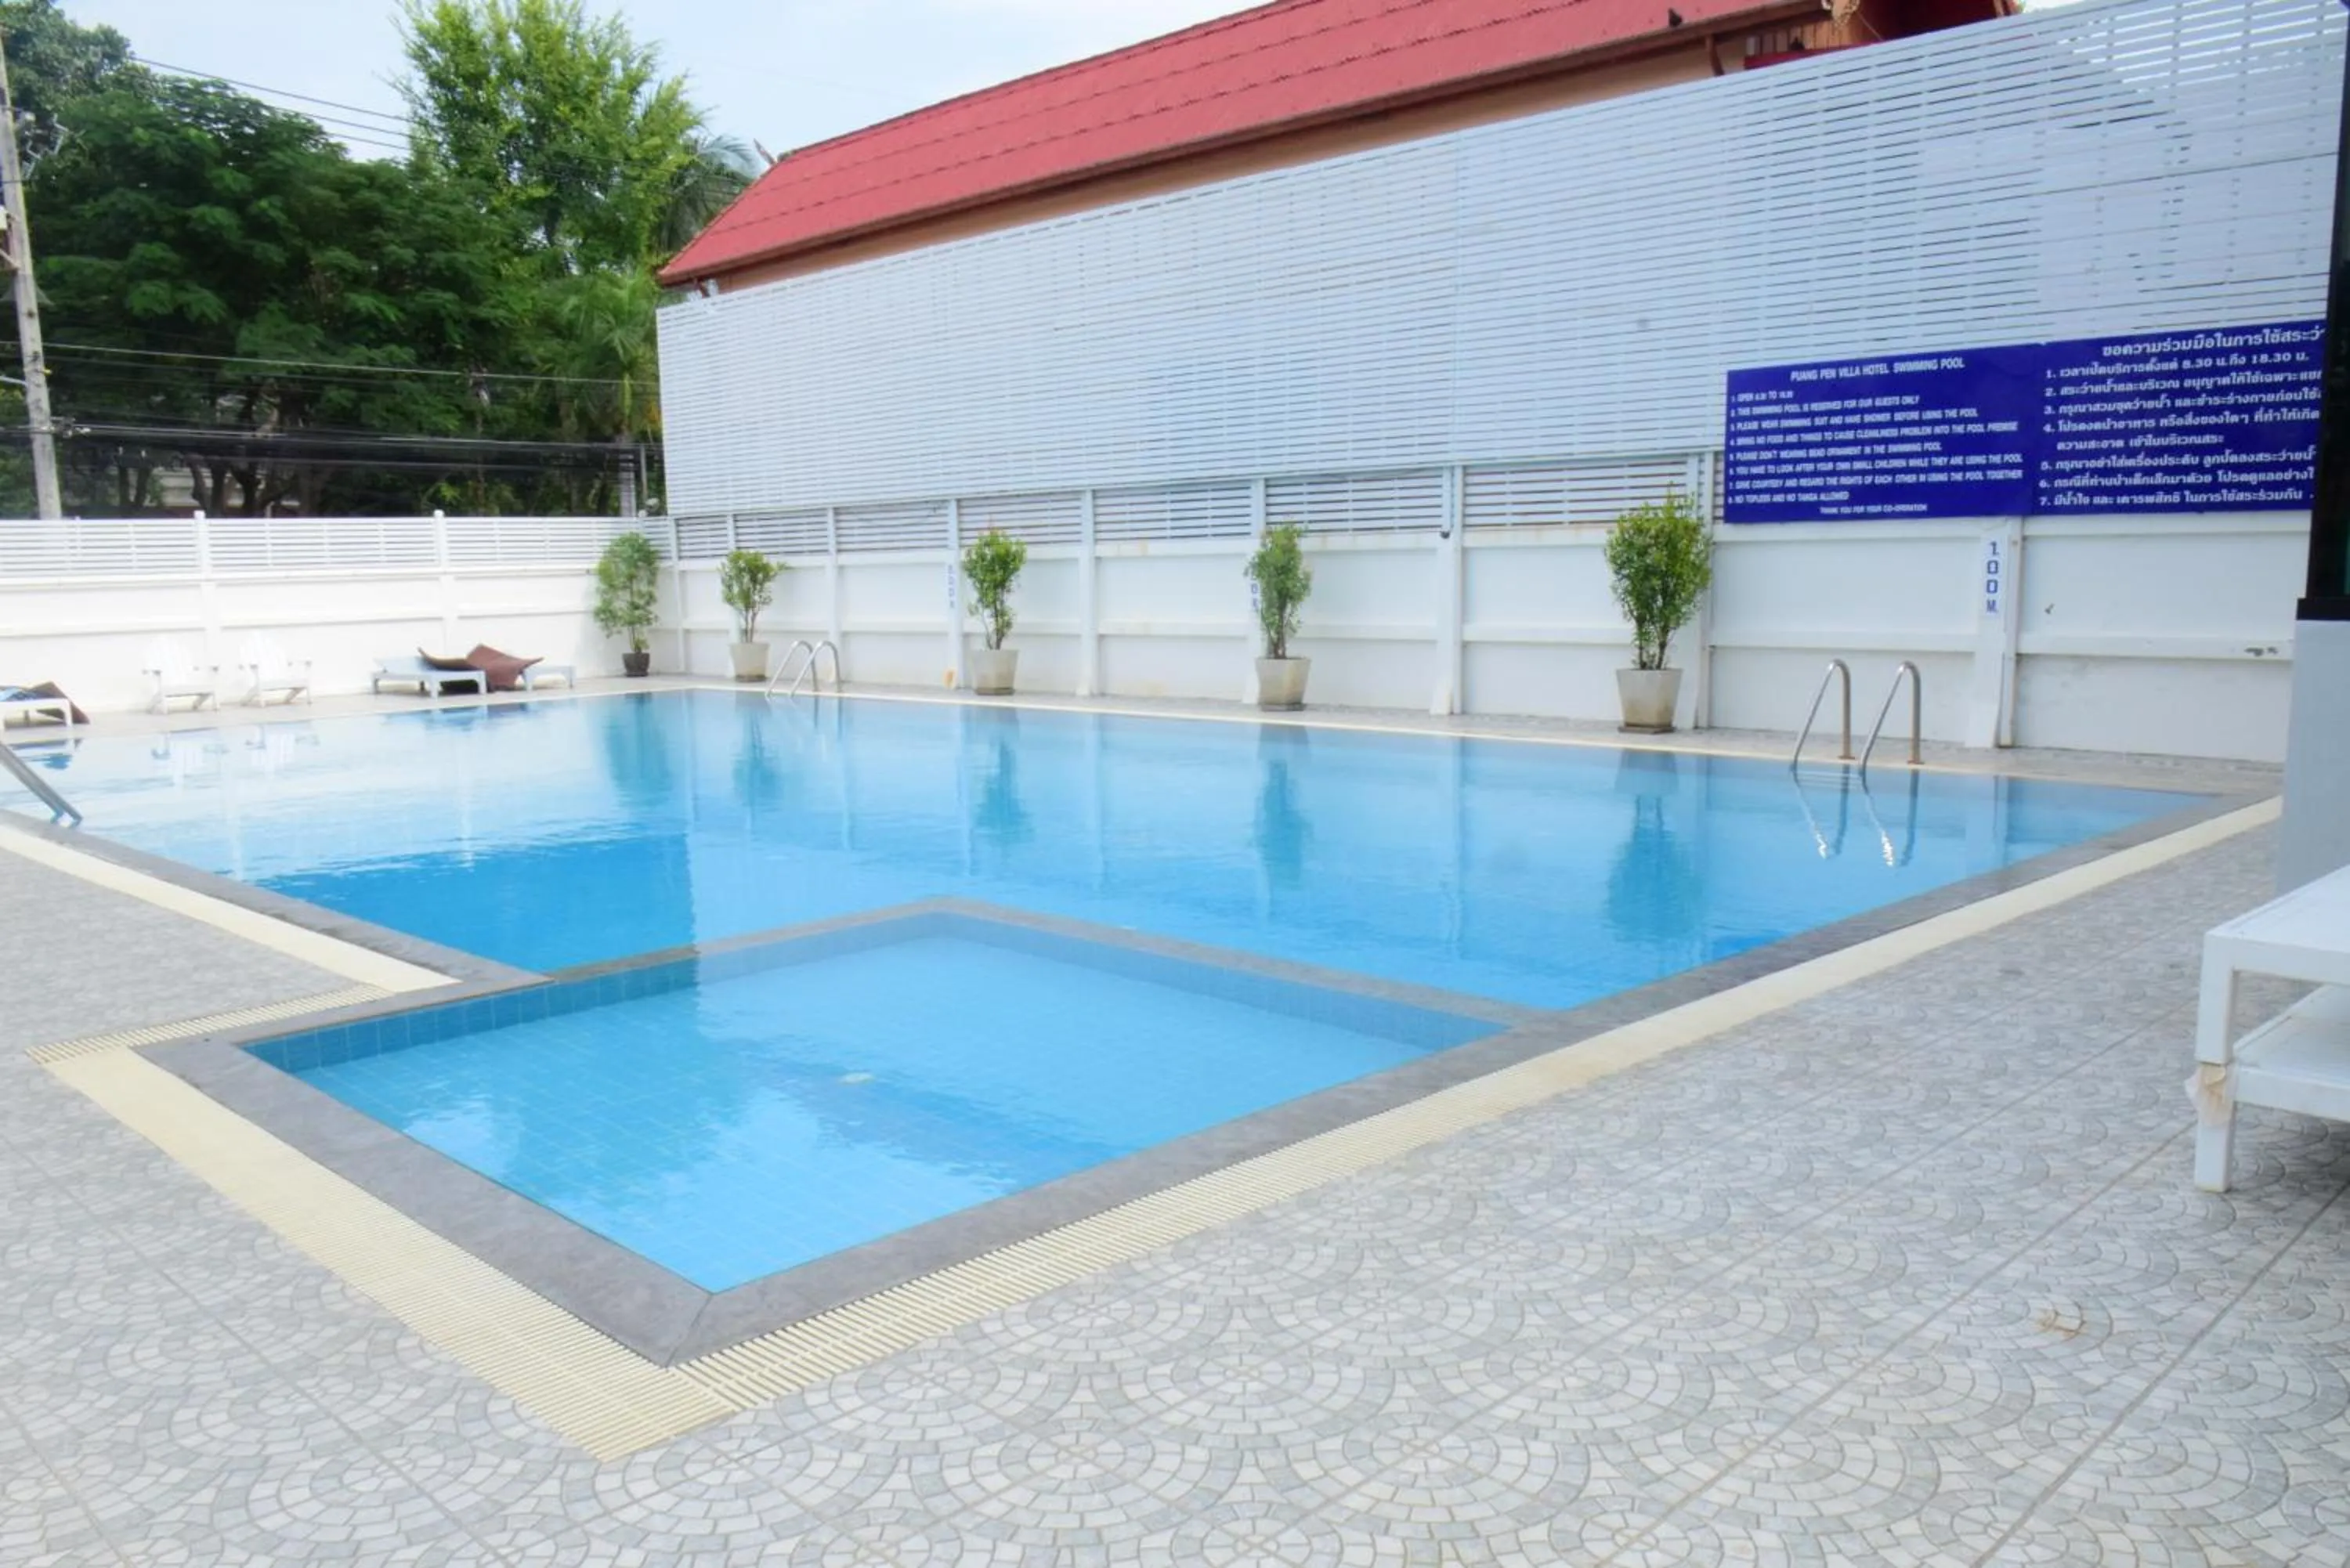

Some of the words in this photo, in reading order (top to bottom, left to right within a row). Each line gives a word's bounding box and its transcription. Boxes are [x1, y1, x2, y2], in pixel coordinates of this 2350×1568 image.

[1789, 369, 1819, 381] PUANG
[1819, 367, 1837, 379] PEN
[1837, 365, 1861, 378] VILLA
[1861, 363, 1889, 375] HOTEL
[1893, 359, 1938, 373] SWIMMING
[1940, 356, 1964, 369] POOL
[2046, 369, 2056, 378] 1.
[2182, 358, 2213, 369] 8.30
[2252, 352, 2292, 364] 18.30
[1737, 392, 1754, 403] OPEN
[1768, 391, 1777, 400] TO
[2044, 387, 2056, 397] 2.
[1737, 406, 1751, 416] THIS
[1751, 404, 1783, 415] SWIMMING
[1783, 403, 1801, 413] POOL
[1802, 403, 1809, 412] IS
[1843, 399, 1856, 409] FOR
[1857, 398, 1872, 408] OUR
[1875, 396, 1900, 406] GUESTS
[1901, 395, 1918, 405] ONLY
[2044, 406, 2055, 414] 3.
[1735, 421, 1759, 431] PLEASE
[1779, 417, 1811, 428] SWIMMING
[1829, 415, 1842, 425] AND
[1844, 414, 1861, 425] HAVE
[1863, 413, 1891, 423] SHOWER
[1893, 410, 1919, 421] BEFORE
[1922, 410, 1942, 420] USING
[1944, 409, 1958, 418] THE
[1959, 407, 1978, 417] POOL
[1755, 435, 1766, 445] NO
[1766, 434, 1784, 444] FOOD
[1784, 433, 1799, 443] AND
[1823, 432, 1833, 441] TO
[1932, 425, 1950, 435] INTO
[1951, 424, 1965, 434] THE
[1966, 423, 1985, 433] POOL
[2043, 424, 2055, 432] 4.
[1735, 450, 1758, 461] PLEASE
[1864, 445, 1871, 454] IN
[1873, 444, 1885, 453] THE
[1887, 442, 1922, 453] SWIMMING
[1923, 441, 1941, 451] POOL
[1735, 466, 1748, 475] YOU
[1748, 465, 1766, 475] HAVE
[1766, 464, 1776, 474] TO
[1776, 464, 1794, 474] LOOK
[1795, 463, 1815, 473] AFTER
[1816, 462, 1834, 471] YOUR
[1835, 461, 1851, 471] OWN
[1851, 461, 1872, 470] SMALL
[1874, 458, 1907, 469] CHILDREN
[1907, 457, 1929, 468] WHILE
[1930, 457, 1947, 467] THEY
[1949, 456, 1963, 466] ARE
[1965, 455, 1987, 465] USING
[1987, 454, 2001, 464] THE
[2003, 453, 2023, 463] POOL
[1735, 480, 1750, 490] GIVE
[1784, 478, 1798, 488] AND
[1825, 476, 1838, 486] THE
[1838, 475, 1863, 486] RIGHTS
[1864, 475, 1872, 484] OF
[1895, 473, 1917, 483] OTHER
[1918, 472, 1925, 482] IN
[1926, 471, 1948, 482] USING
[1950, 471, 1963, 481] THE
[1965, 470, 1983, 480] POOL
[1986, 468, 2023, 479] TOGETHER
[2039, 479, 2051, 488] 6.
[1734, 494, 1744, 504] NO
[1771, 493, 1785, 502] AND
[1785, 493, 1795, 502] NO
[1818, 491, 1849, 500] ALLOWED
[2039, 497, 2052, 506] 7.
[1820, 506, 1838, 515] THANK
[1839, 505, 1852, 514] YOU
[1865, 504, 1882, 513] YOUR
[1882, 503, 1927, 512] CO-OPERATION
